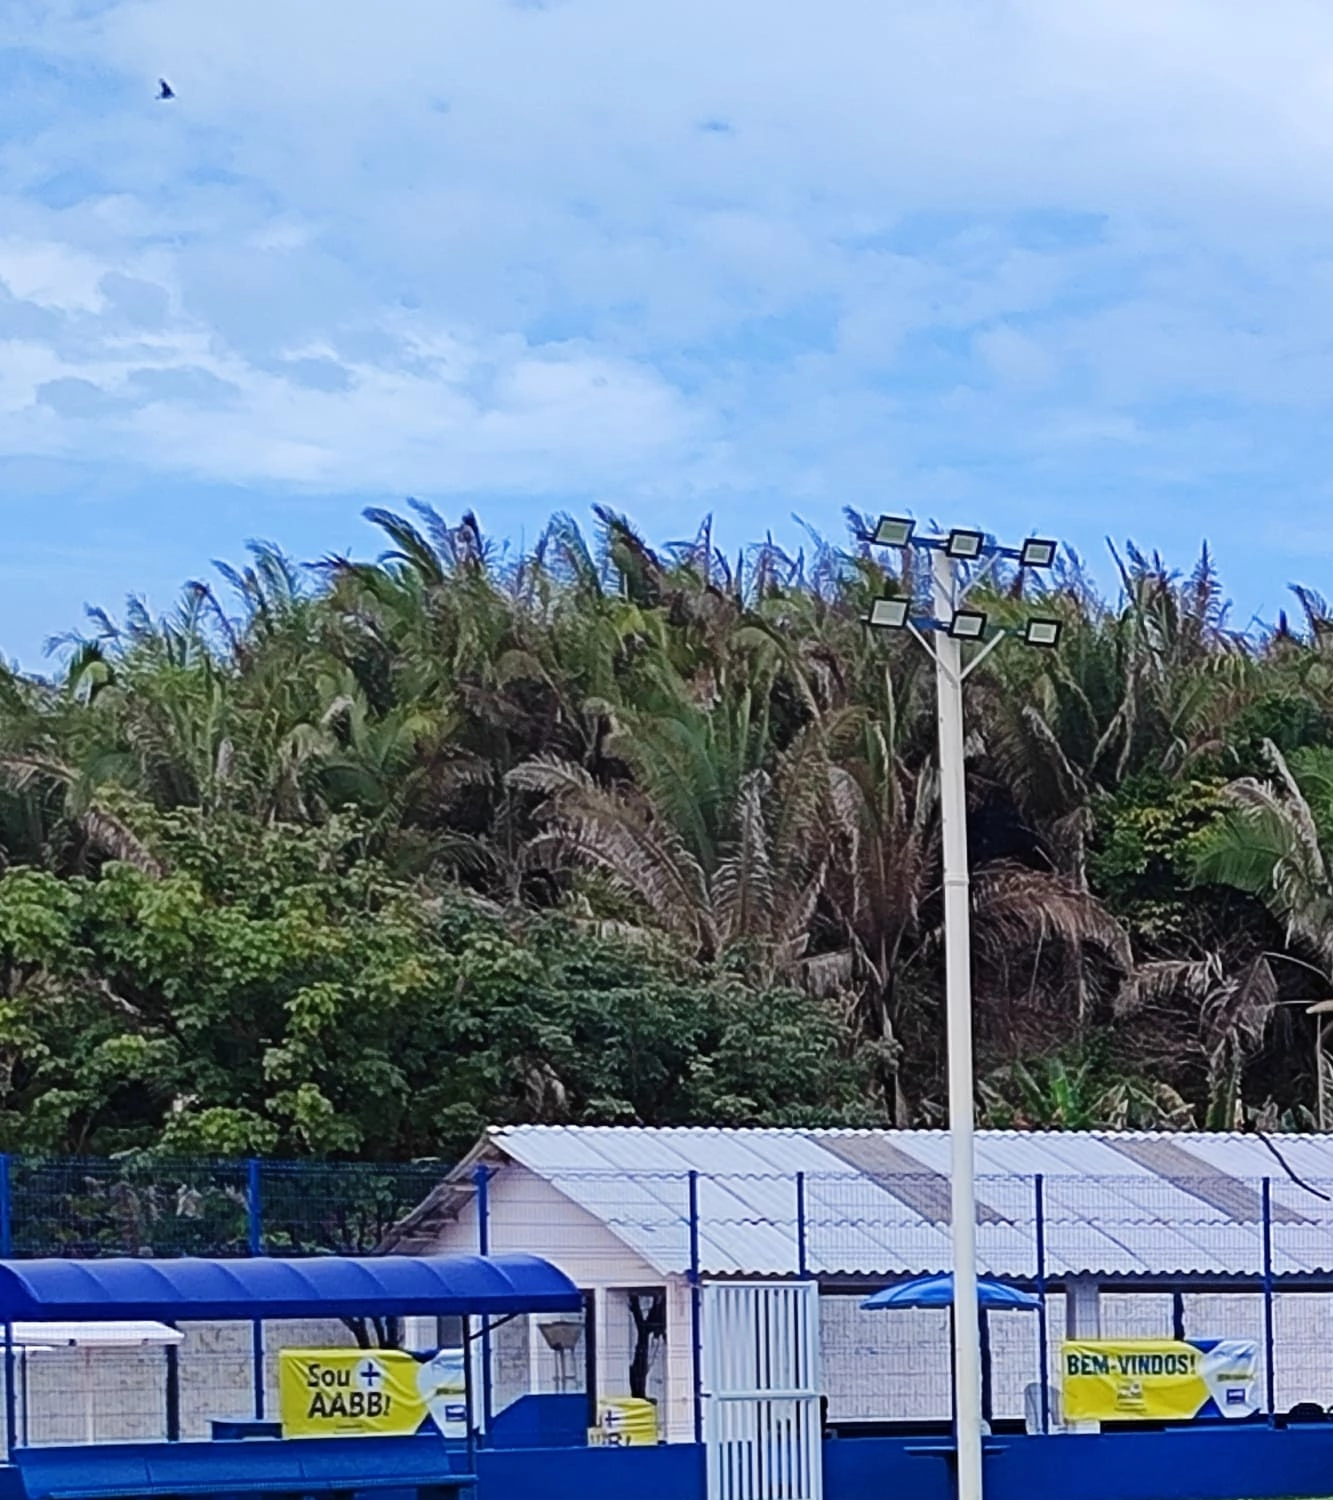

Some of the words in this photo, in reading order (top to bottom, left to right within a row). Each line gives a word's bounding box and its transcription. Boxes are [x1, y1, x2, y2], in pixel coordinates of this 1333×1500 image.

[307, 1363, 350, 1387] Sou
[1067, 1354, 1196, 1376] BEM-VINDOS!
[308, 1391, 391, 1419] AABB!
